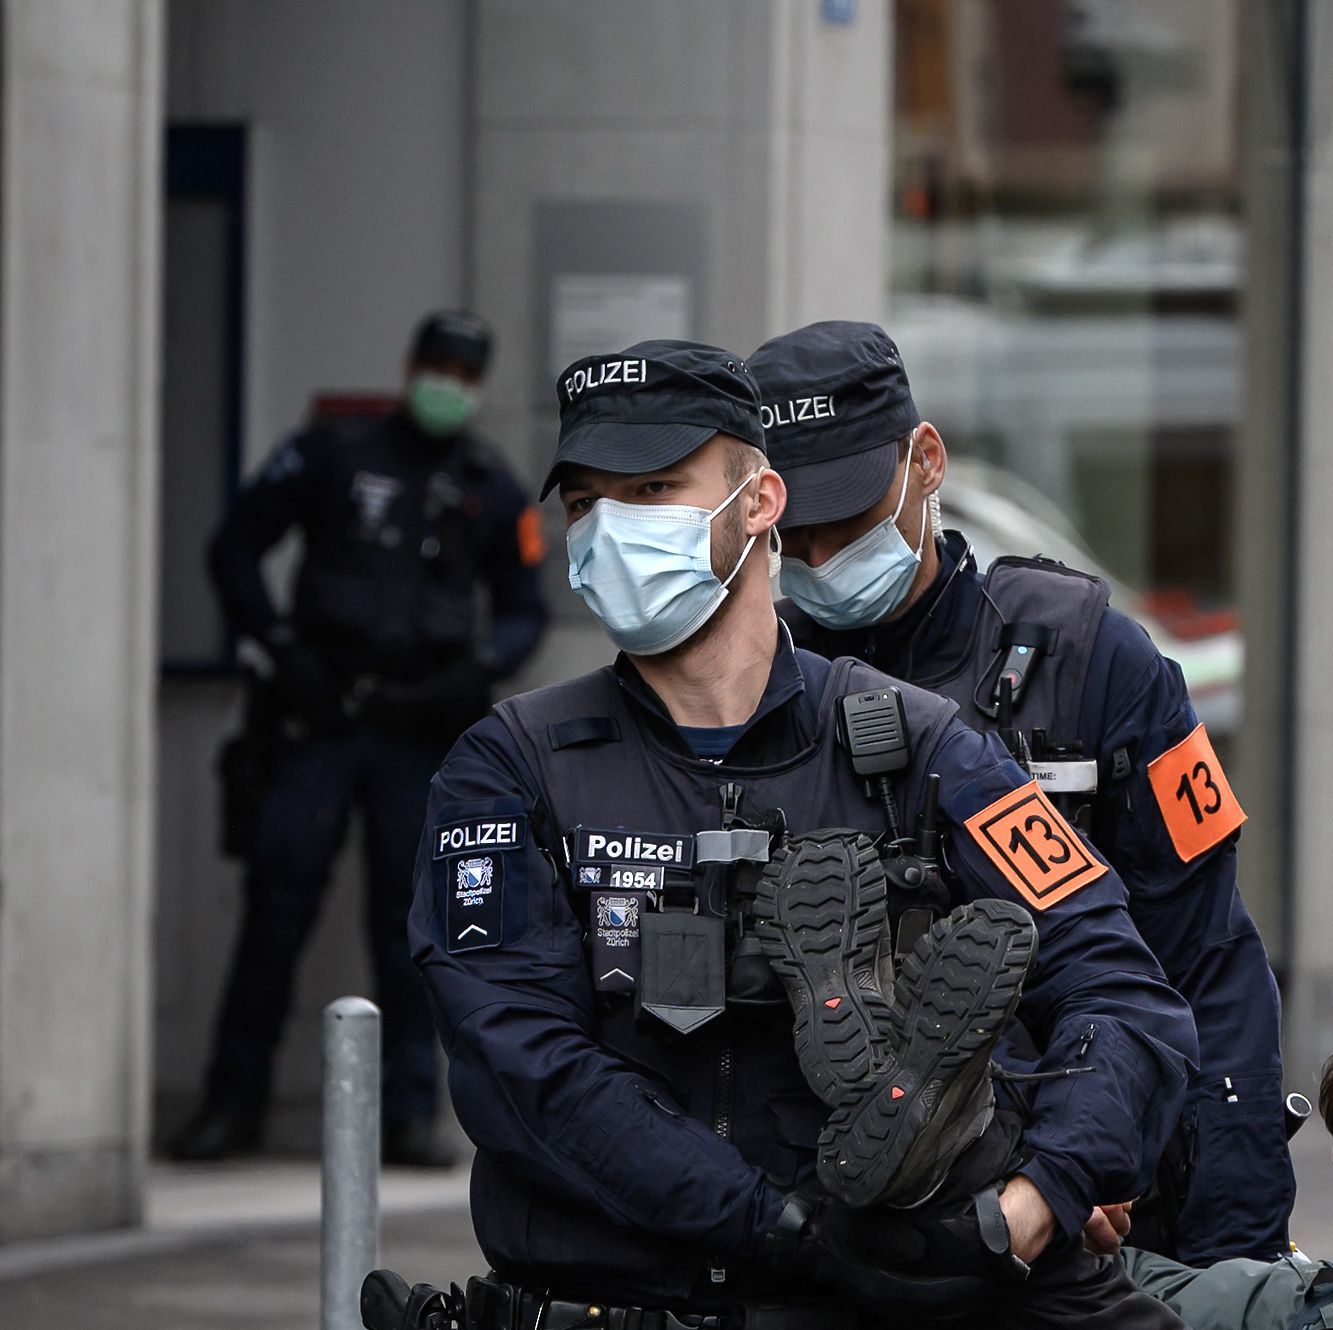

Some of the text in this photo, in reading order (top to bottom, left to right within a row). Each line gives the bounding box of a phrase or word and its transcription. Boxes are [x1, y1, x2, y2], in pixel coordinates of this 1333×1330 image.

[565, 359, 648, 401] POLIZEI
[760, 396, 836, 429] OLIZEI
[1176, 760, 1222, 825] 13
[440, 822, 517, 852] POLIZEI
[587, 834, 683, 863] Polizei
[1008, 815, 1072, 874] 13
[611, 870, 657, 889] 1954
[597, 928, 640, 939] Stadtpolizei
[606, 937, 630, 947] Zürich
